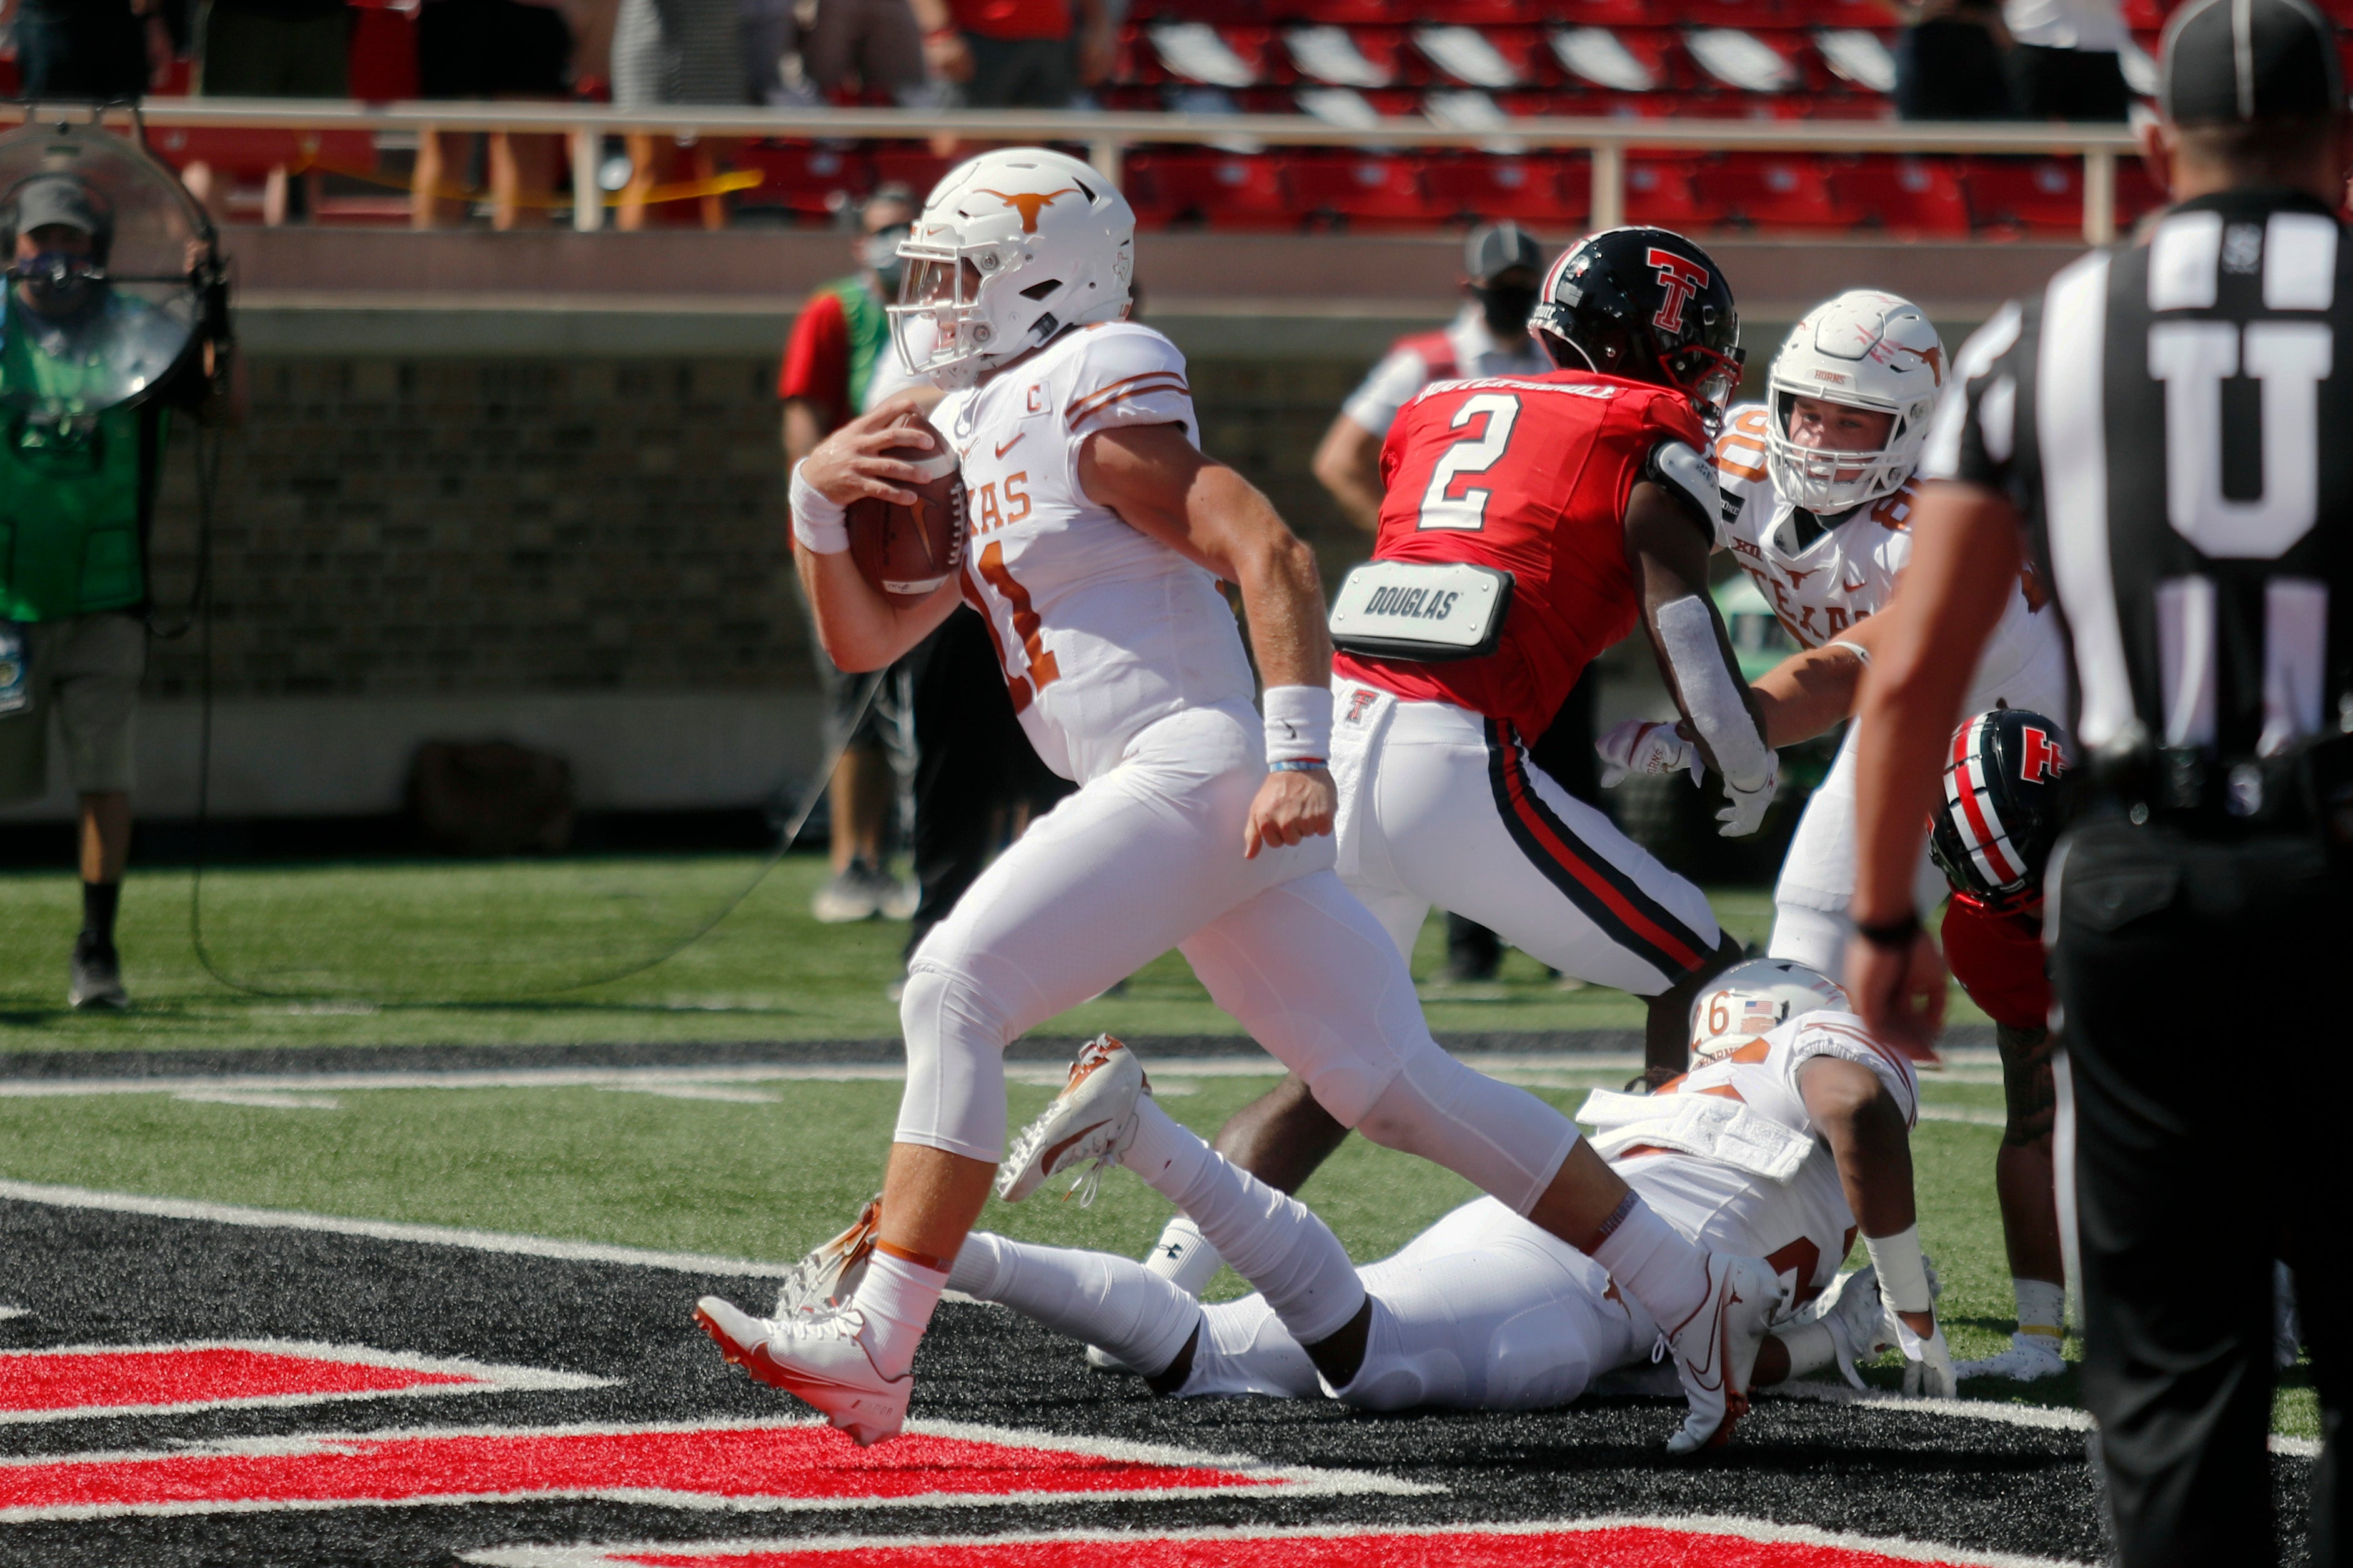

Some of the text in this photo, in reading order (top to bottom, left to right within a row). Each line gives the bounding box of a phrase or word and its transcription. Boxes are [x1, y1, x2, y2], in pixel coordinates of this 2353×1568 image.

[1814, 370, 1846, 384] HORNS
[1027, 384, 1042, 414] C
[2147, 320, 2334, 559] U
[1417, 393, 1523, 532] 2
[1364, 586, 1459, 620] DOUGLAS
